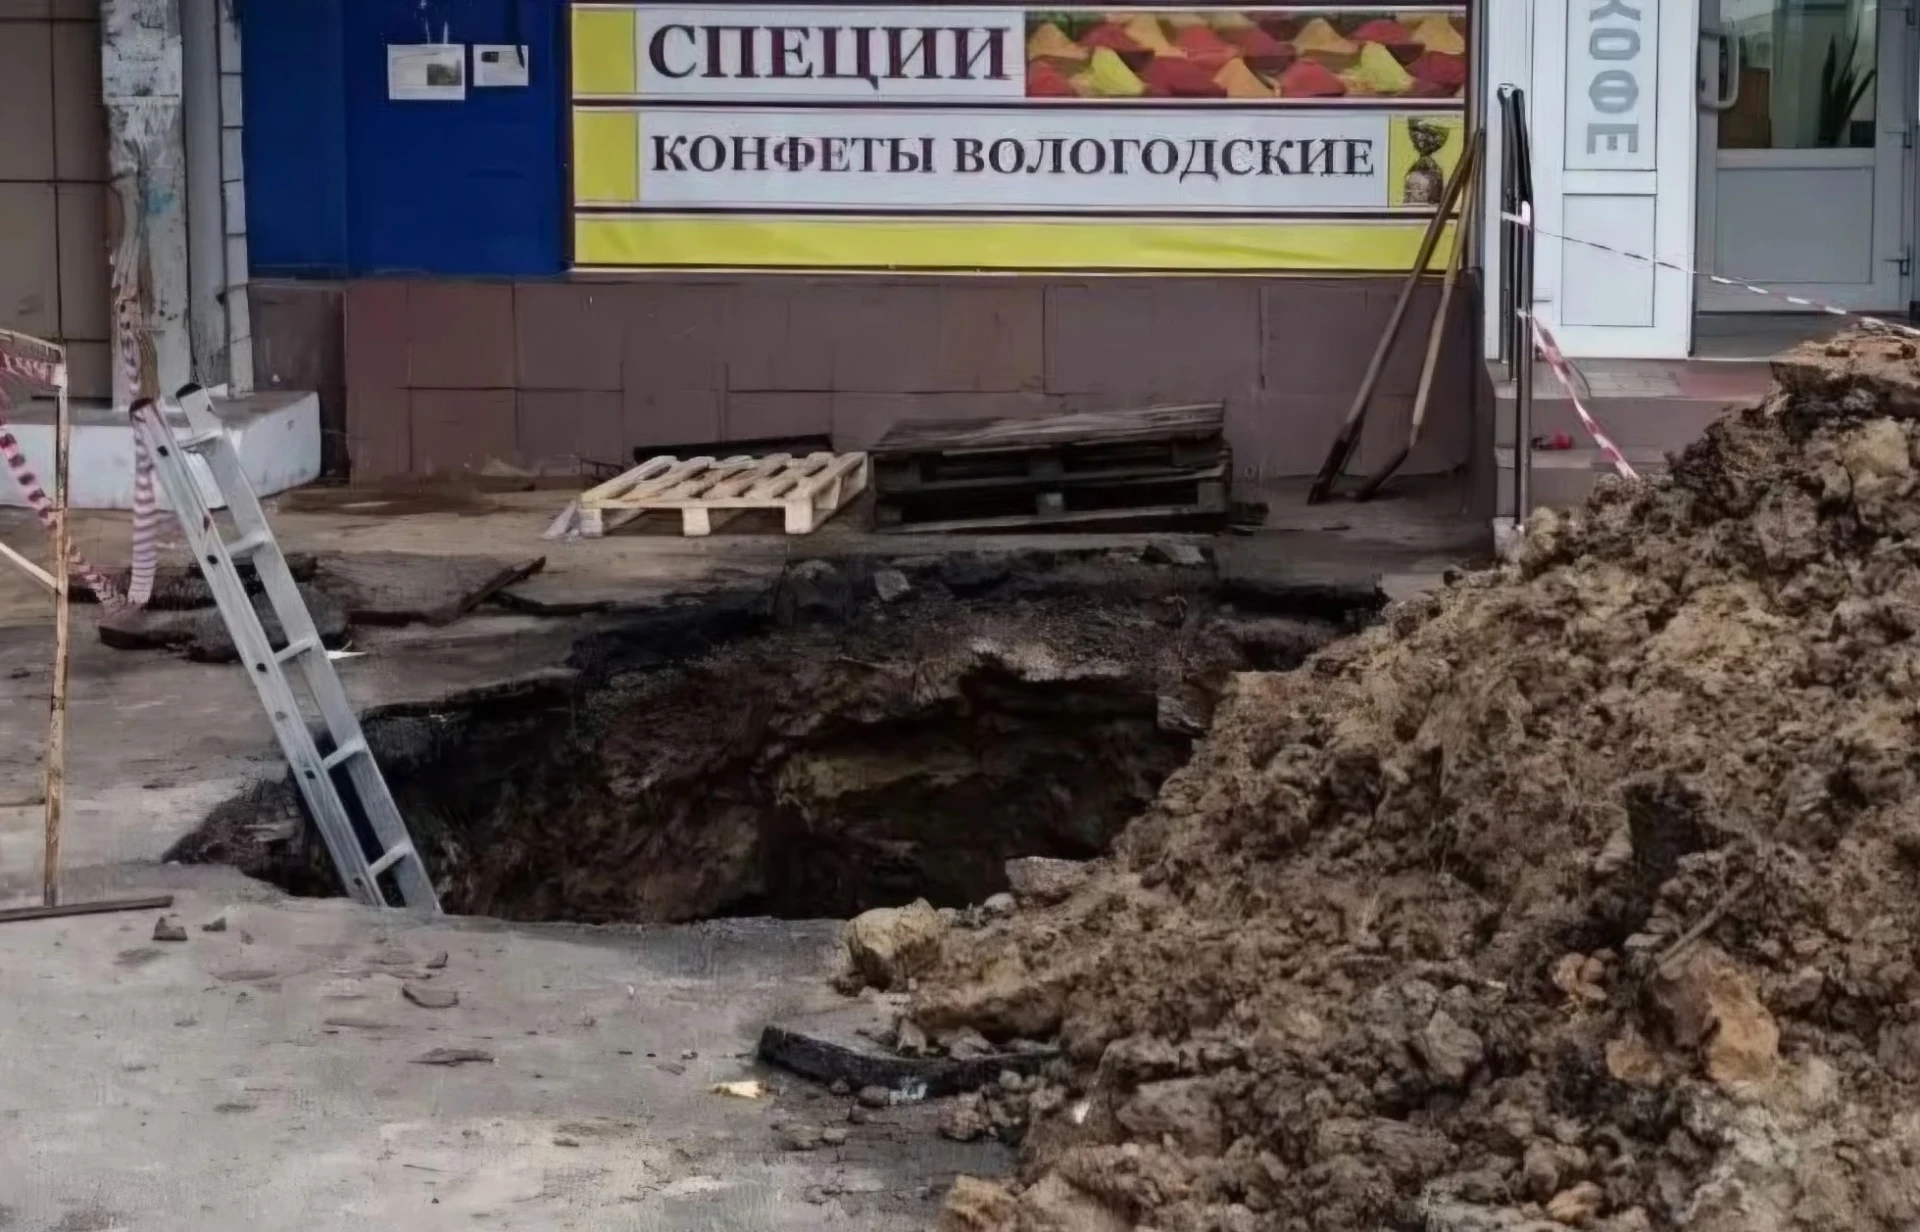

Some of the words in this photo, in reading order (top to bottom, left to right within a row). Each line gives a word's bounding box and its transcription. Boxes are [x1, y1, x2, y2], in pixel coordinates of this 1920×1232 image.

[648, 23, 1011, 91] СПЕЦИИ
[651, 134, 935, 174] КОНФЕТЫ
[953, 137, 1375, 183] ВОЛОГОДСКИЕ
